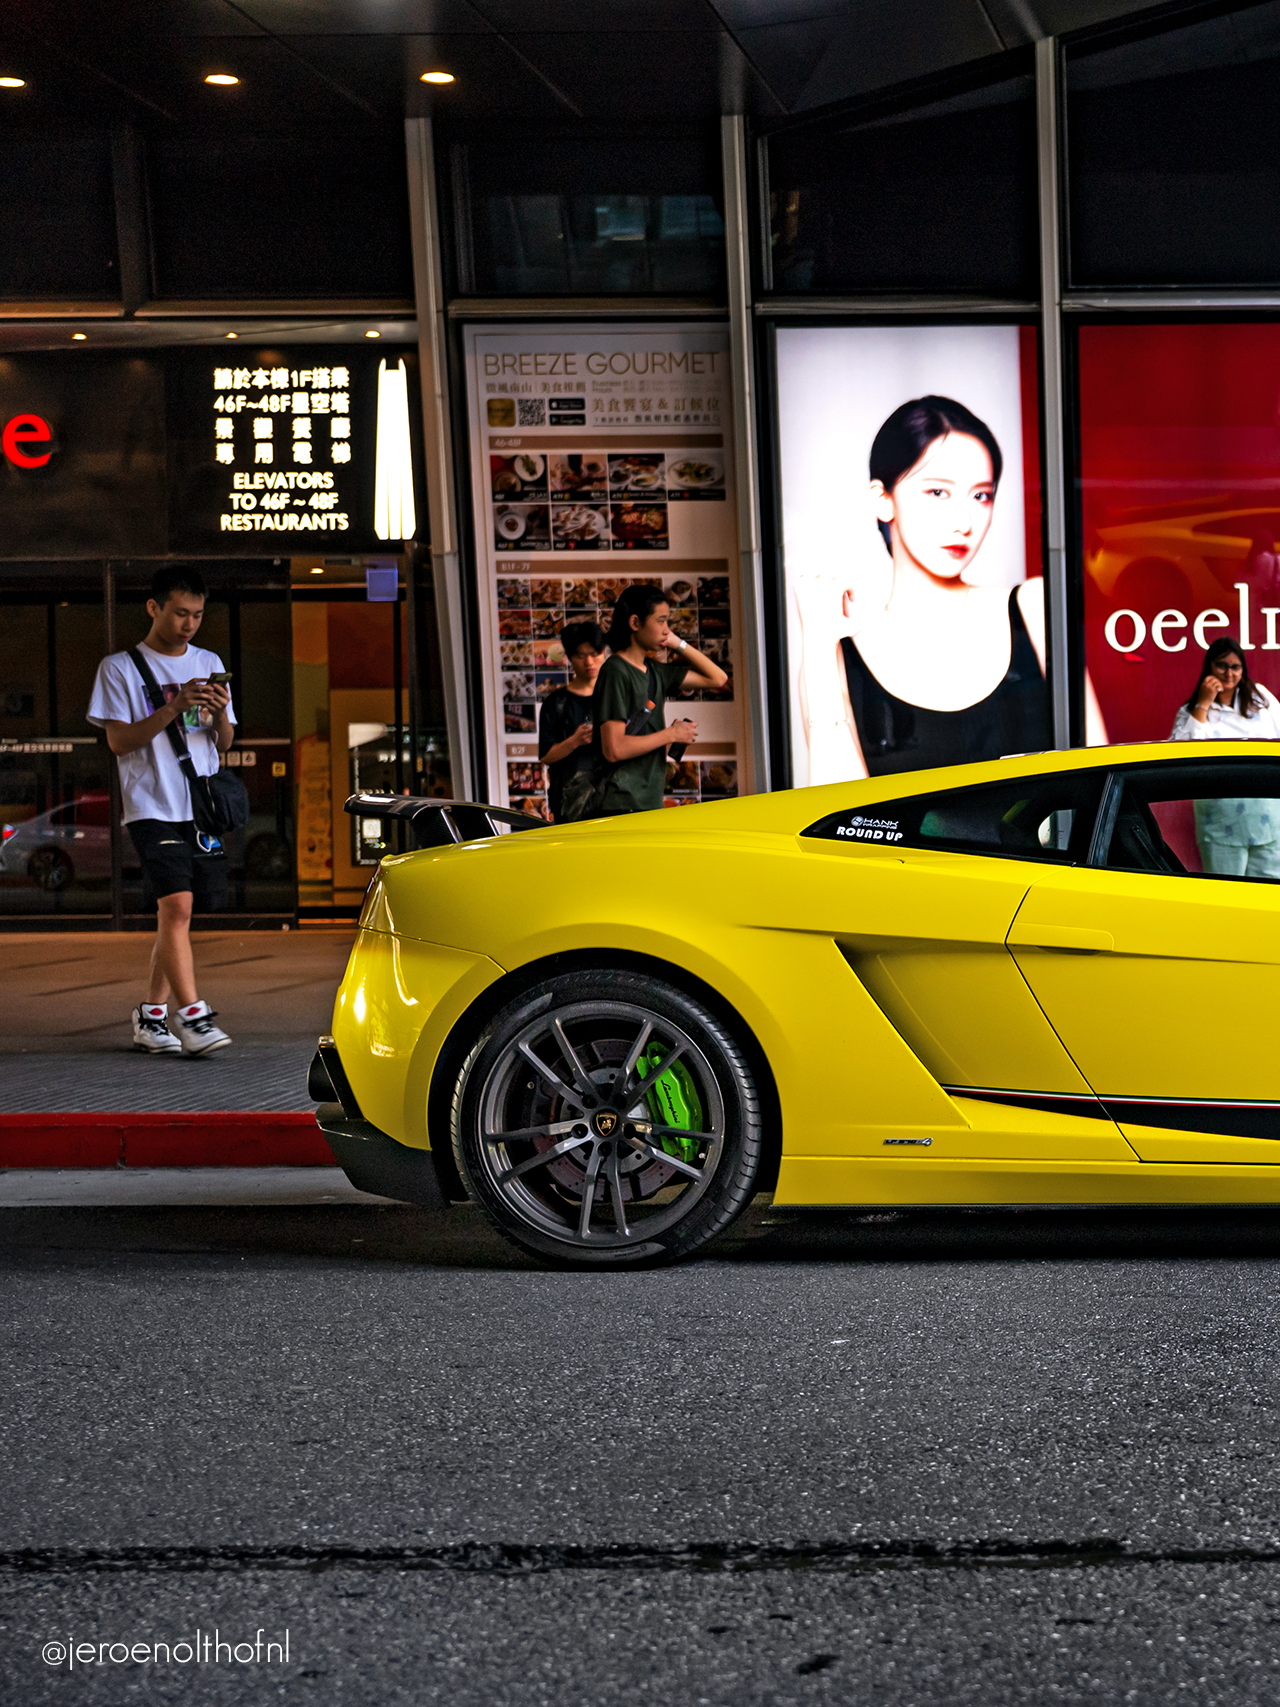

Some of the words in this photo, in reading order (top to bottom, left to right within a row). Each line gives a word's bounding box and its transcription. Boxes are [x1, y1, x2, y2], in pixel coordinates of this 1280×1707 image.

[484, 352, 578, 376] BREEZE
[585, 351, 720, 375] GOURMET
[233, 471, 335, 490] ELEVATORS
[228, 492, 257, 511] TO
[259, 492, 290, 510] 46F
[307, 492, 339, 510] 48F
[220, 513, 350, 532] RESTAURANTS
[863, 817, 899, 826] HANK
[836, 826, 884, 839] ROUND
[886, 831, 903, 841] UP
